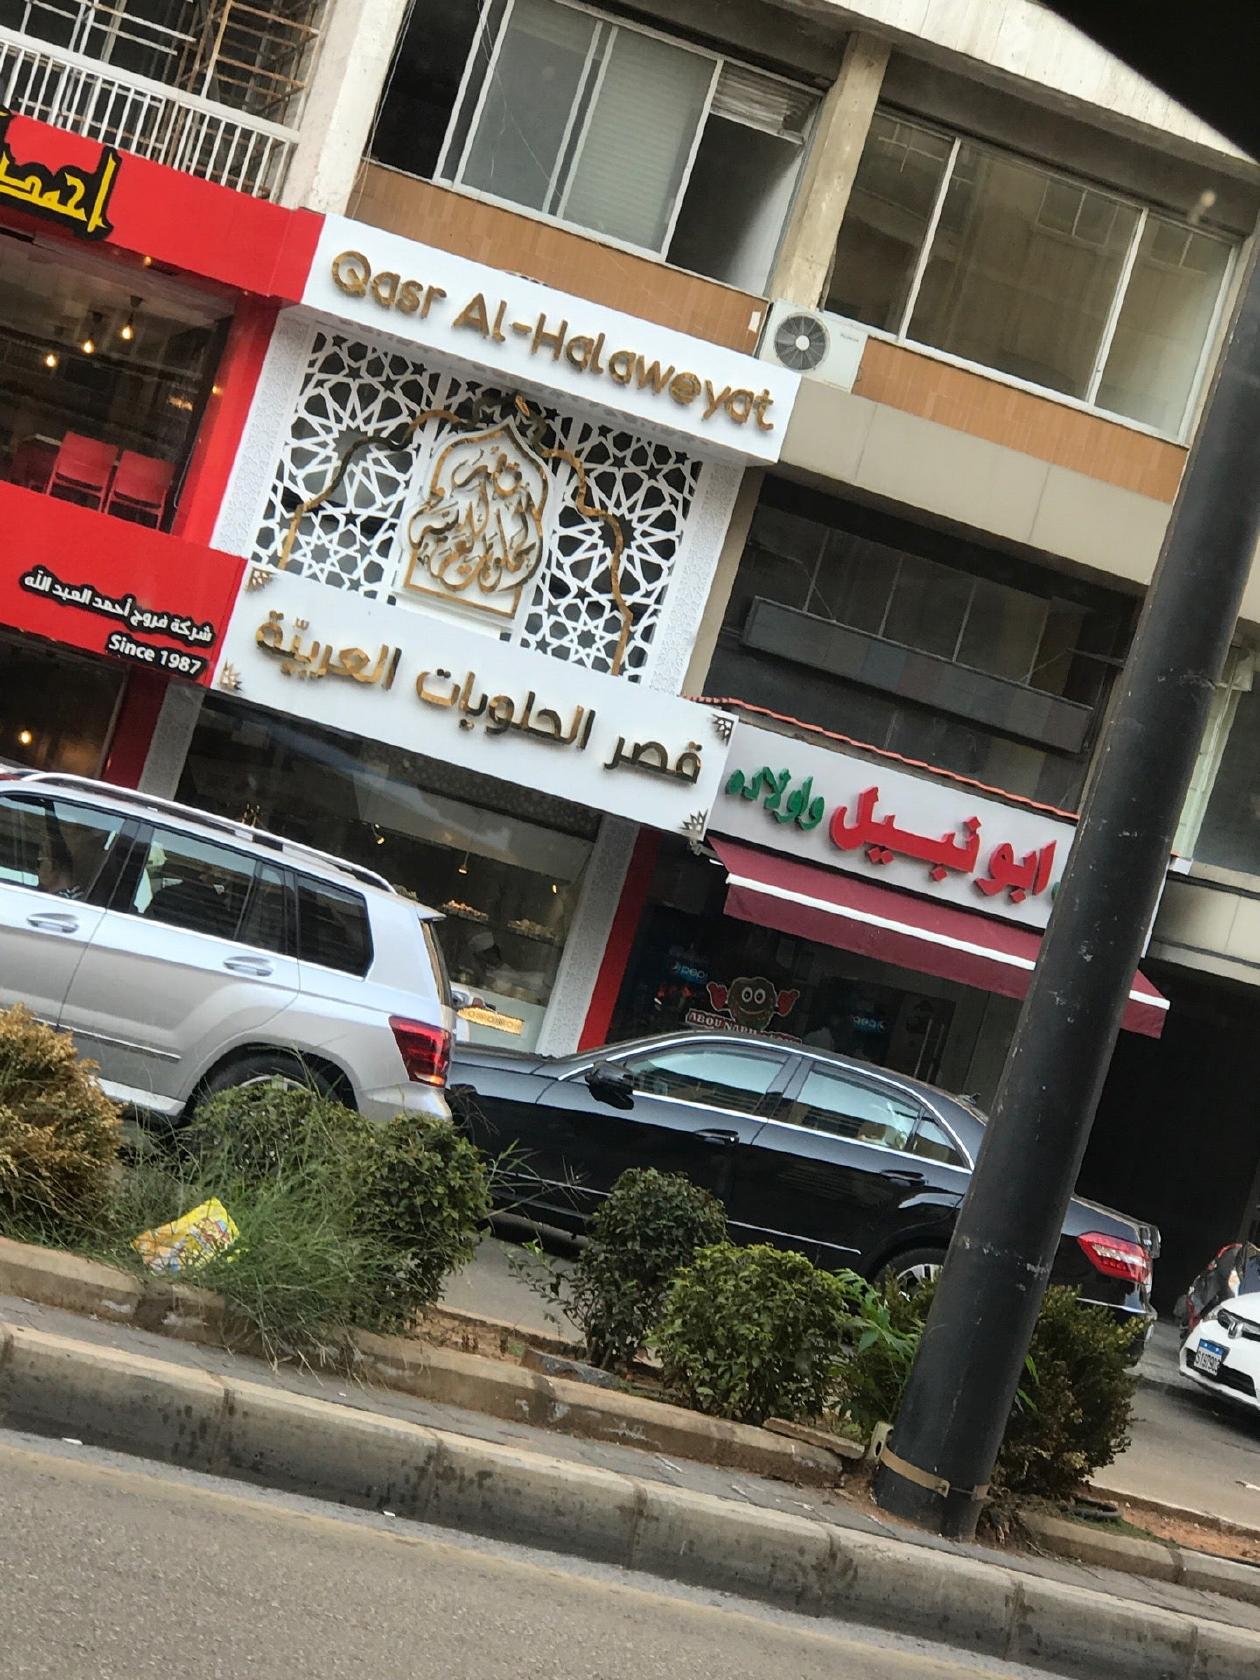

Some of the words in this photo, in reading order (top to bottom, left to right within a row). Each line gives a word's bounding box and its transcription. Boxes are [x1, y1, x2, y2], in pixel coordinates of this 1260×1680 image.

[330, 250, 447, 318] Qasr
[451, 292, 775, 431] Al-Halaweyat
[24, 570, 52, 592] الله
[52, 583, 93, 603] العبد
[93, 596, 133, 617] أحمد
[170, 618, 213, 642] شركة
[109, 633, 155, 661] Since
[160, 650, 203, 675] 1987
[416, 665, 596, 751] الحلويات
[603, 733, 704, 785] قصر
[829, 785, 983, 882] نبيل
[689, 1012, 722, 1027] ABOU
